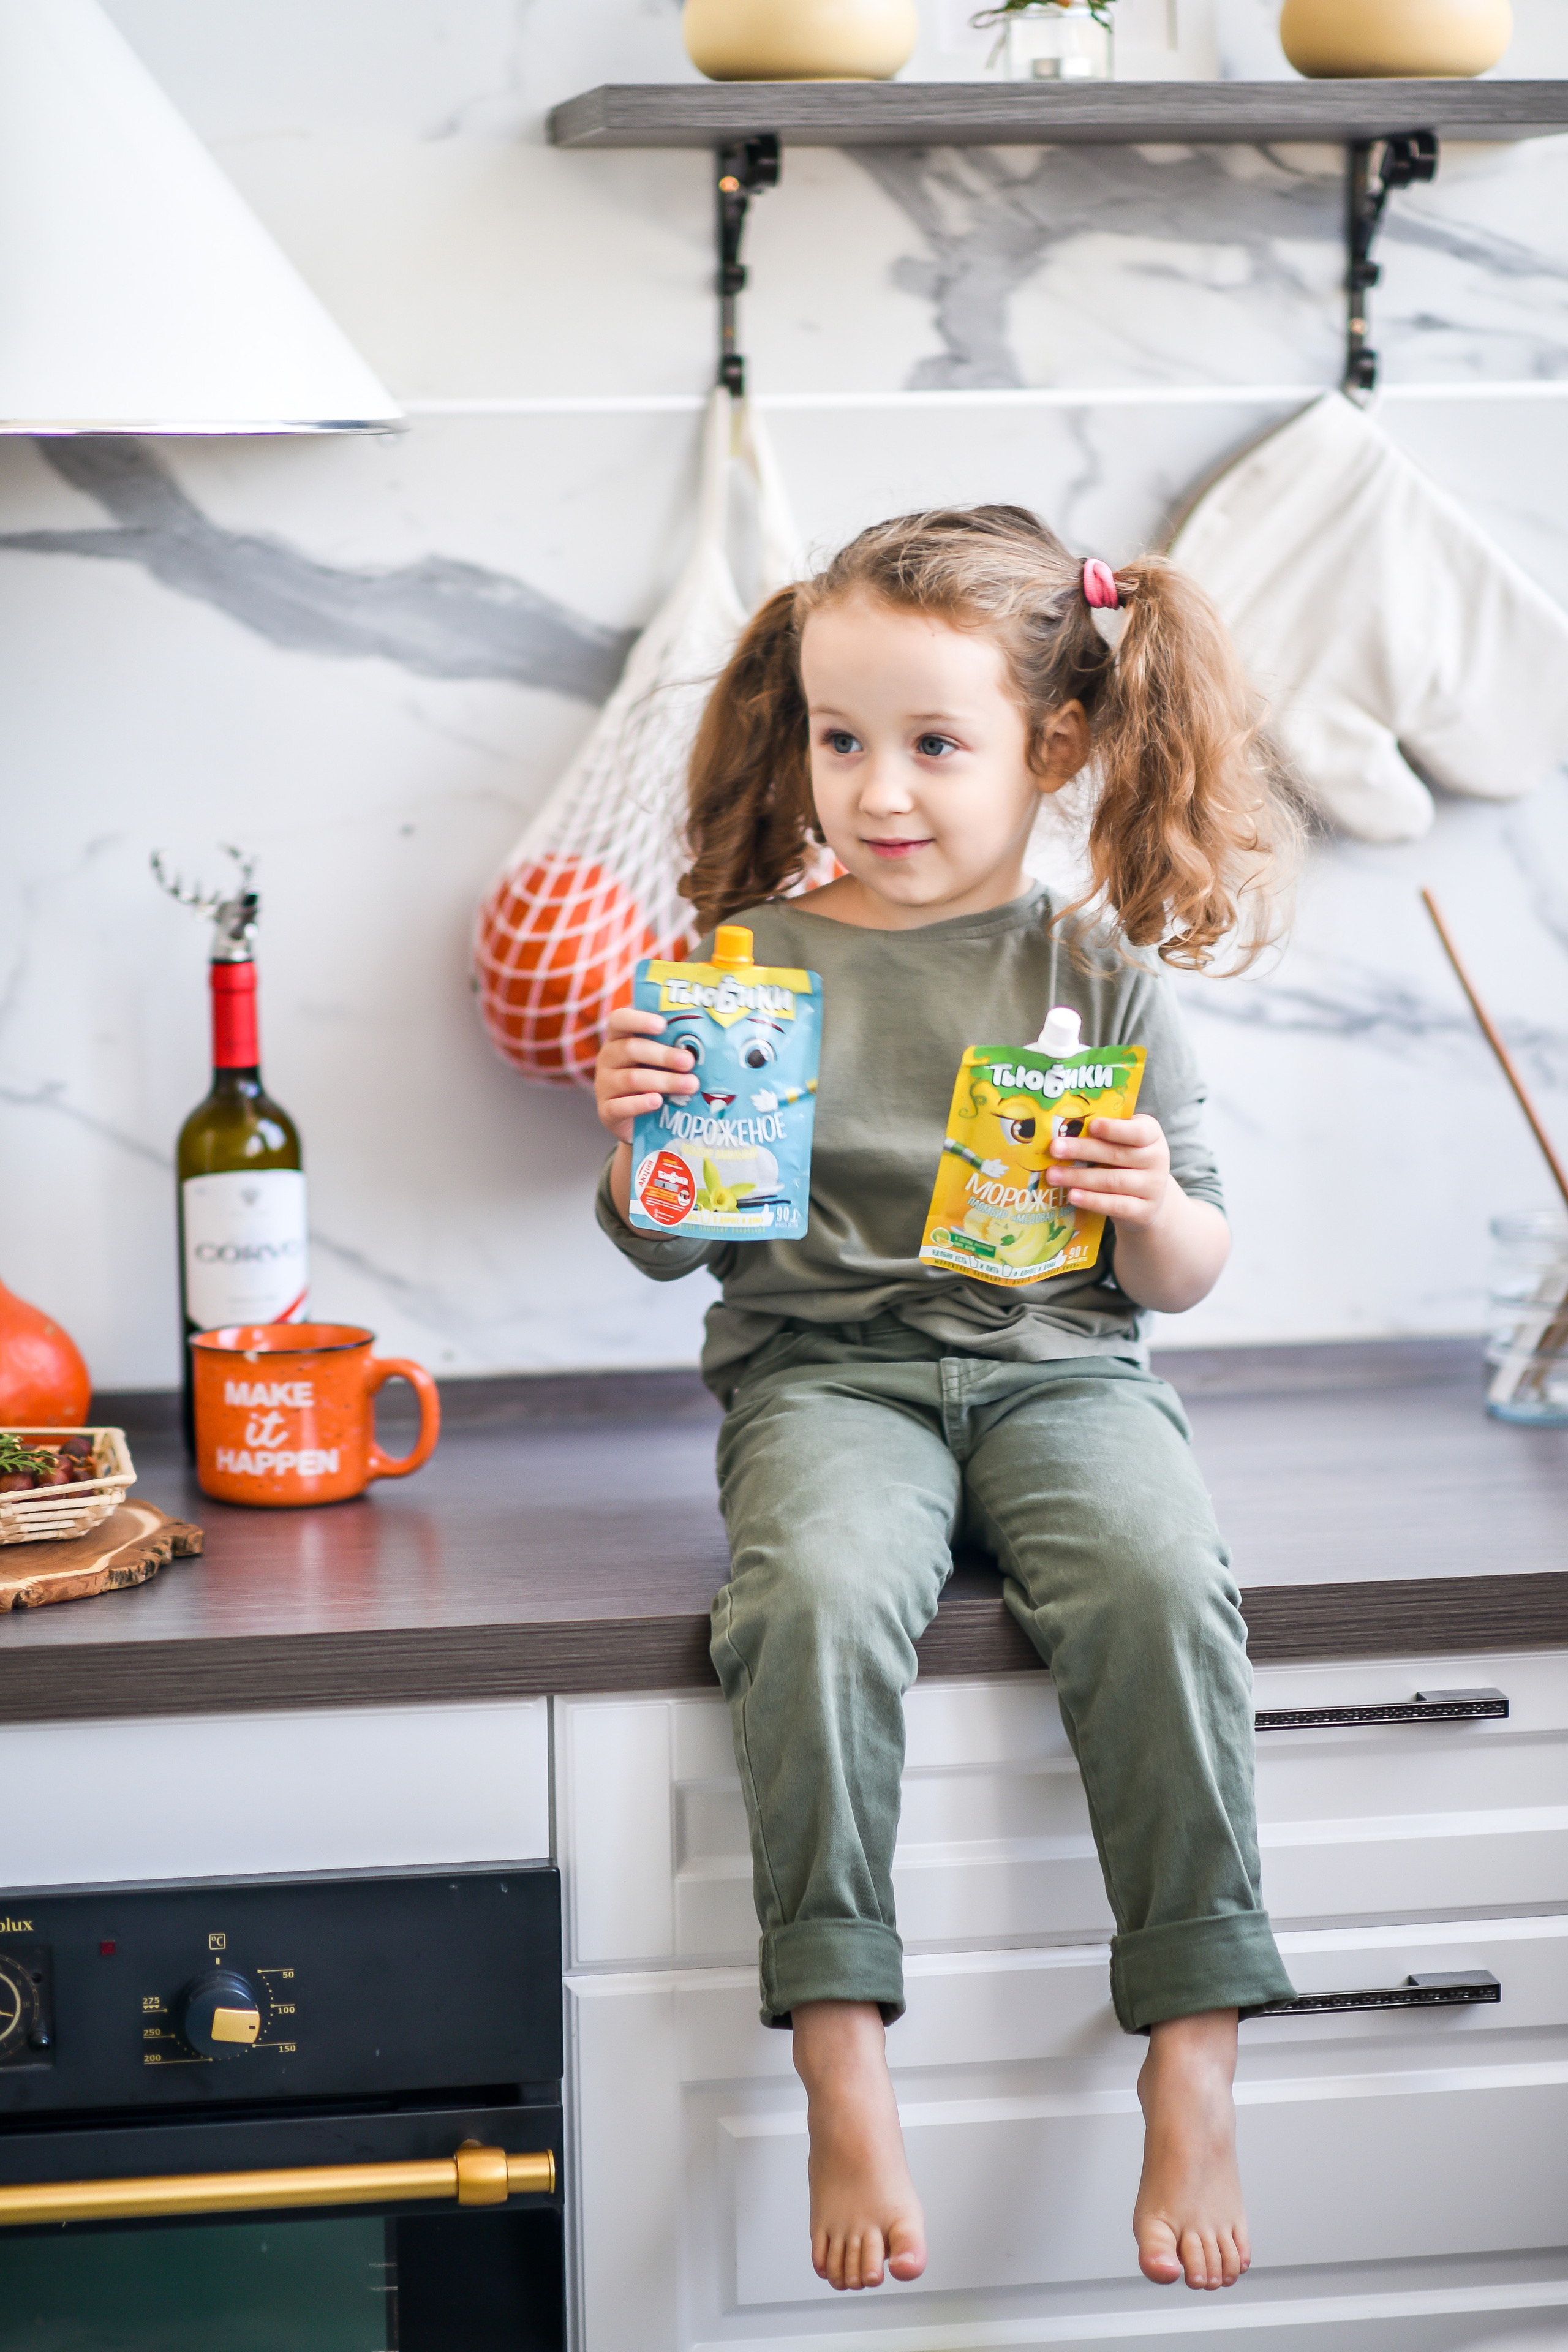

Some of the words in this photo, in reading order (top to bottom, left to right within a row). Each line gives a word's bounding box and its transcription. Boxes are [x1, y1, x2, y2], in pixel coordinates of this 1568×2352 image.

[658, 1104, 788, 1147] МОРОЖЕНОЕ
[965, 1172, 1071, 1212] МОРОЖЕН
[776, 1205, 790, 1222] 90
[967, 1196, 1009, 1219] ПЛОМБИР
[1068, 1245, 1082, 1259] 90
[224, 1381, 315, 1408] MAKE
[245, 1410, 290, 1448] it
[216, 1449, 339, 1476] HAPPEN
[282, 1970, 295, 1979] 50
[277, 2006, 295, 2015] 100
[143, 2028, 160, 2037] 250
[279, 2045, 296, 2053] 150
[144, 2054, 161, 2062] 200
